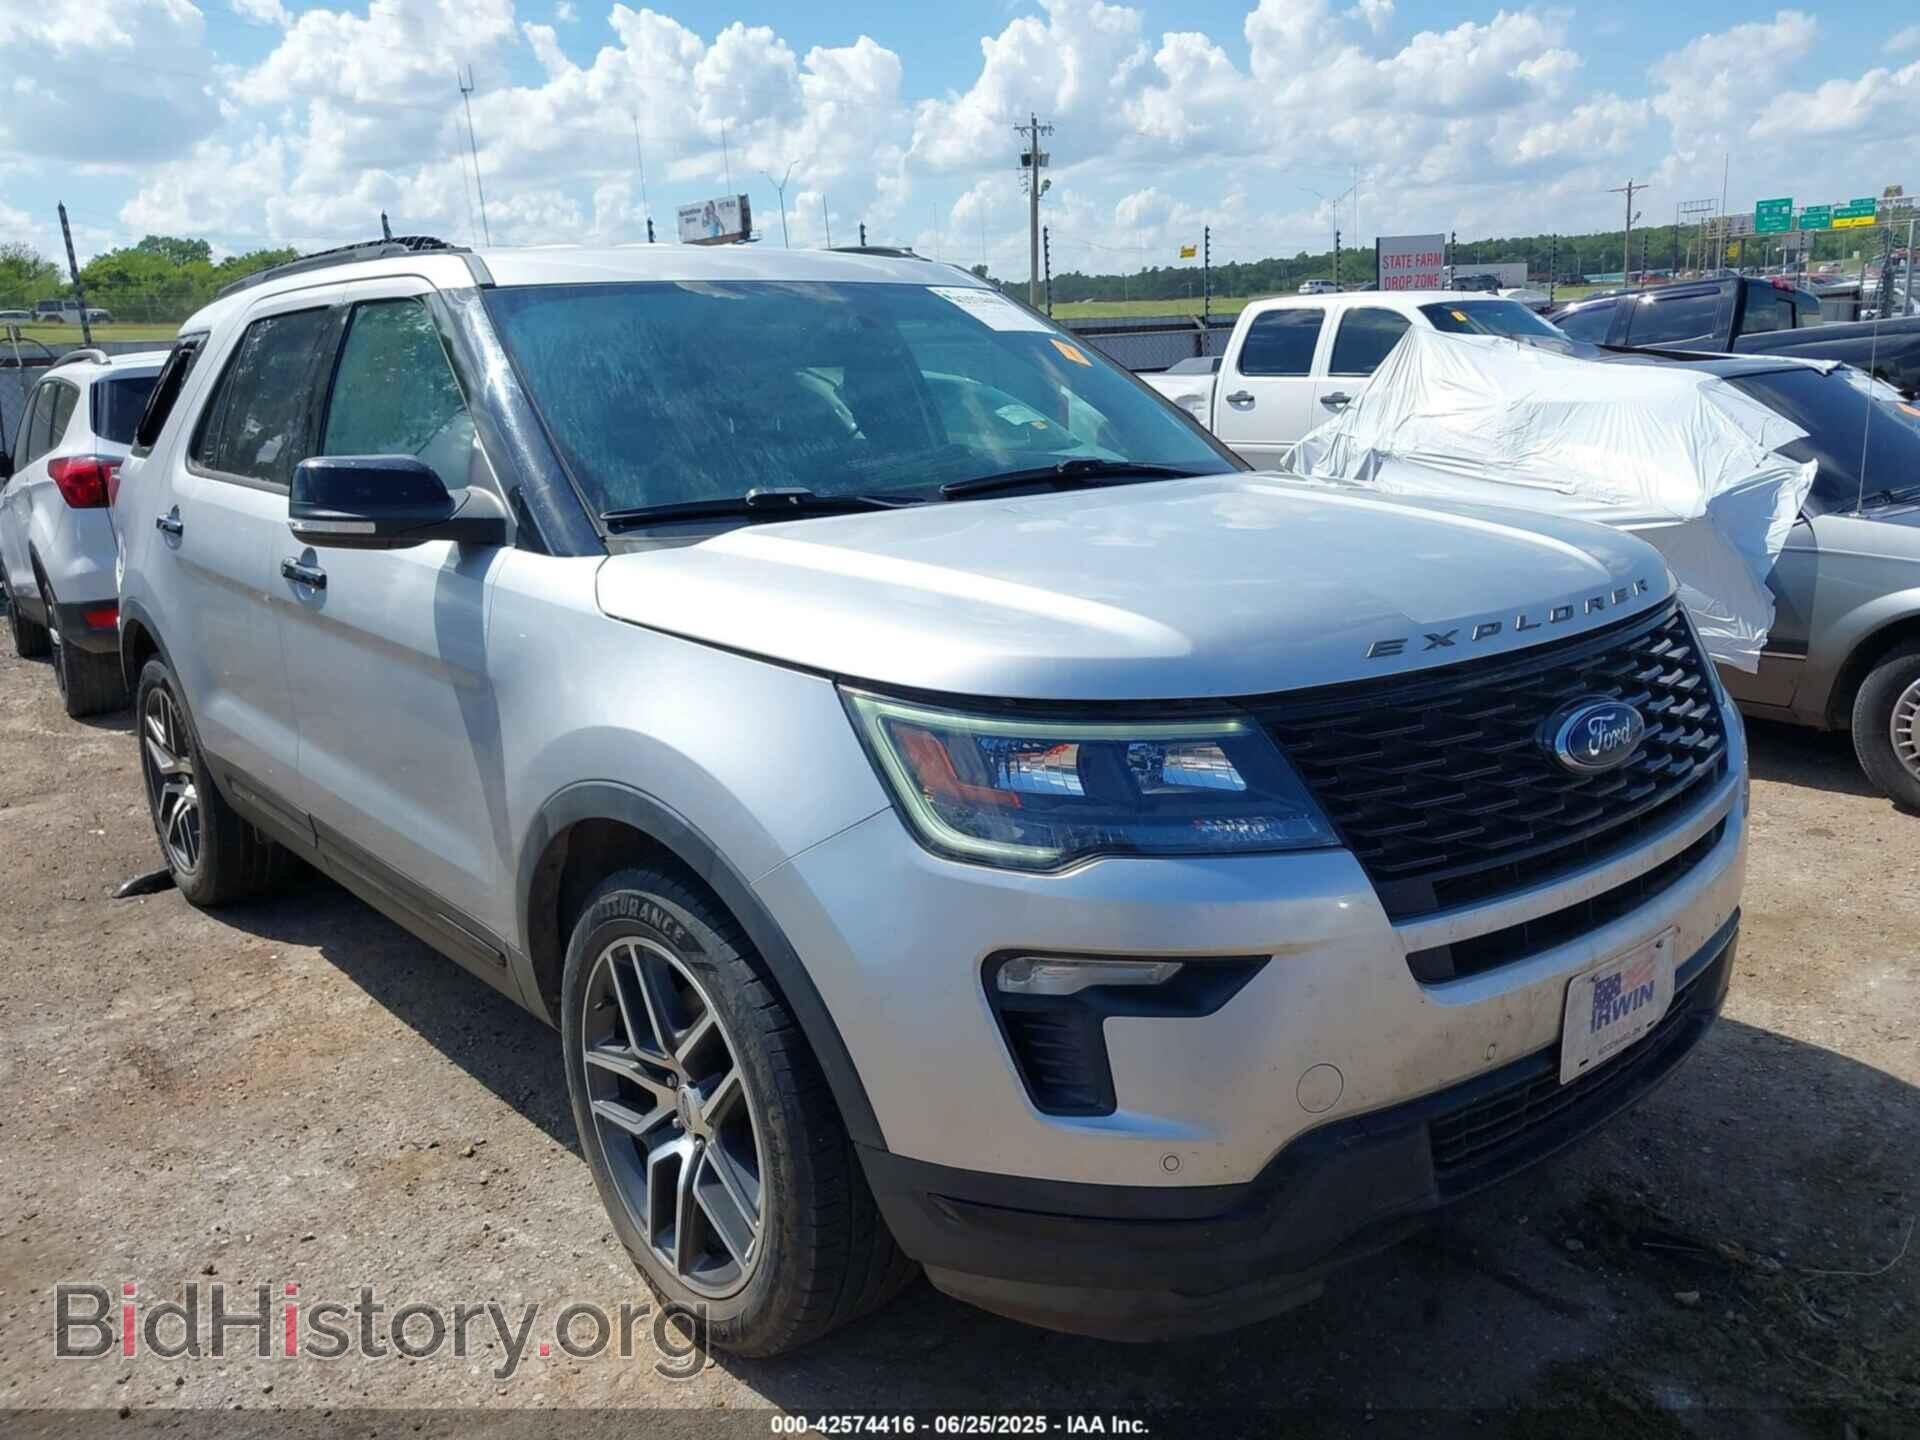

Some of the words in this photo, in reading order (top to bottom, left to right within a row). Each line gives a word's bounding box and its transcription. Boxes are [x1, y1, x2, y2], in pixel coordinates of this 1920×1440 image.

[1383, 253, 1411, 270] STATE
[1415, 252, 1441, 268] FARM
[1385, 275, 1412, 290] DROP
[1415, 272, 1440, 289] ZONE
[1366, 578, 1648, 658] EXPLORER
[1588, 713, 1632, 755] Ford
[1591, 980, 1654, 1034] IRWIN
